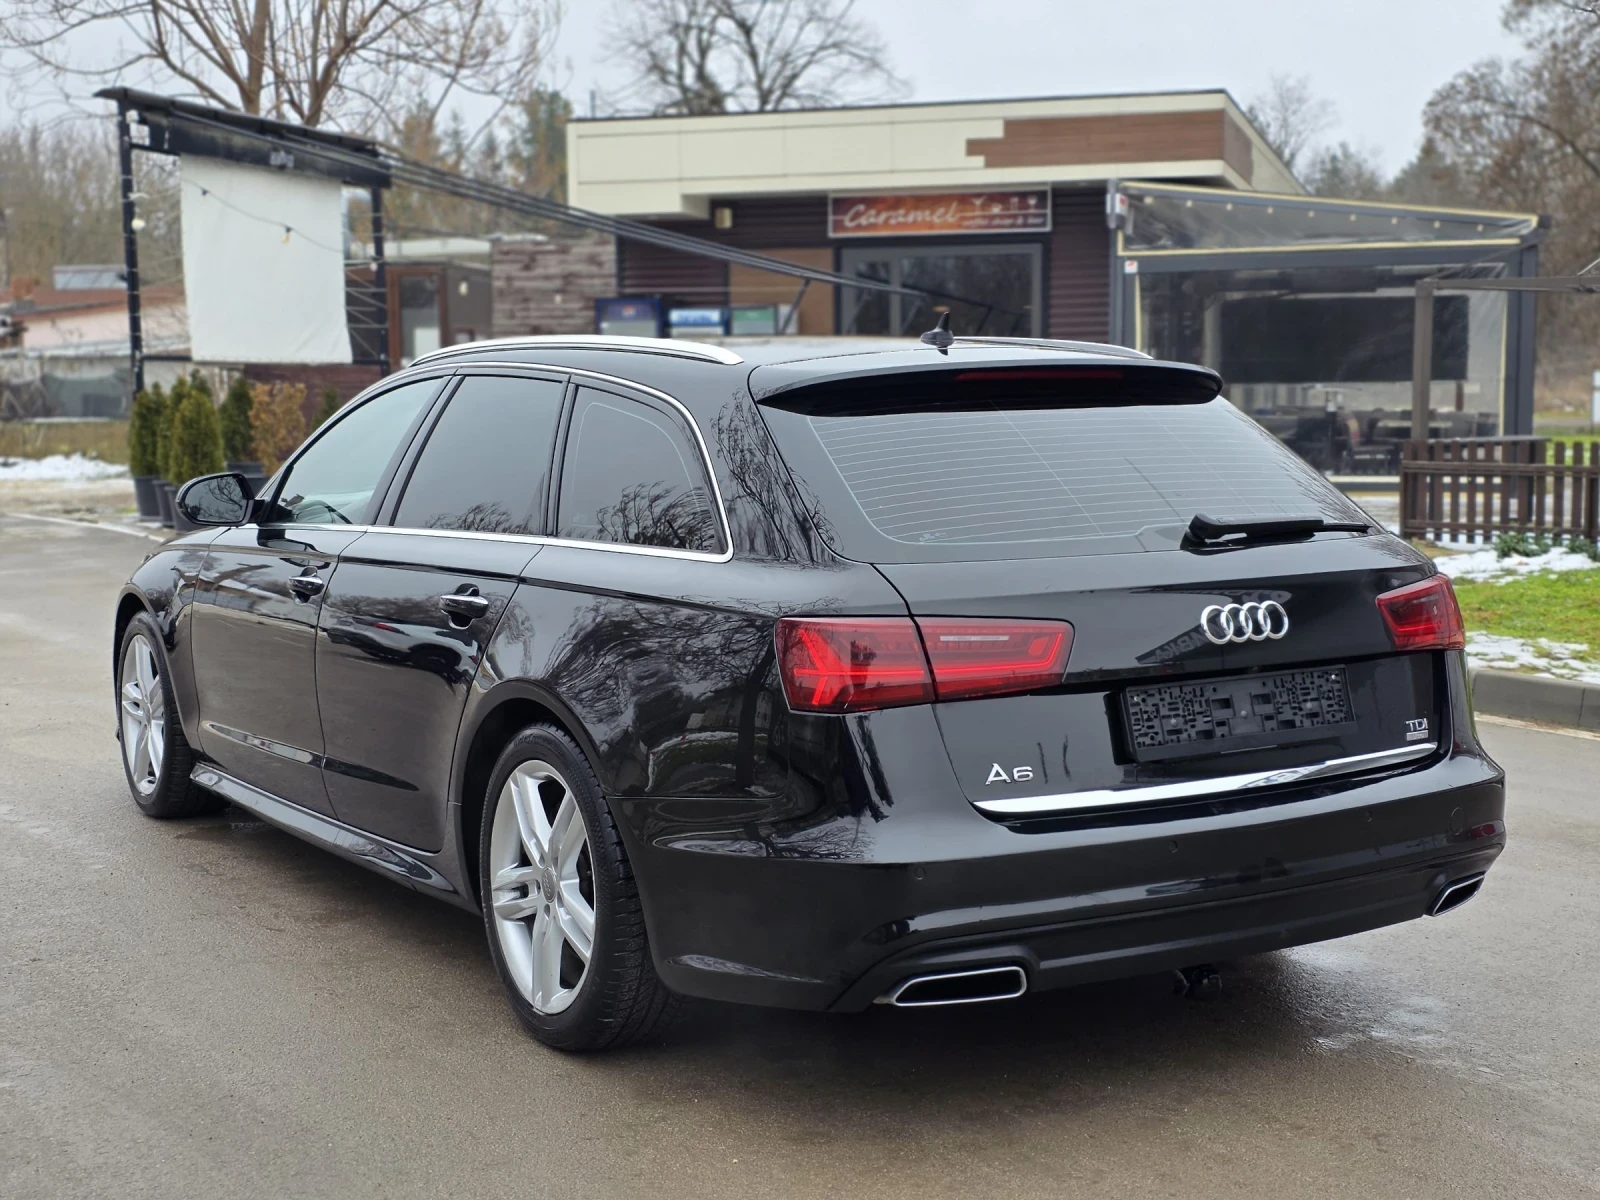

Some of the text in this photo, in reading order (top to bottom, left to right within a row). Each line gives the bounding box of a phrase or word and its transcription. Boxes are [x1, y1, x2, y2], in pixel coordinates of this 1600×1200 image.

[842, 201, 959, 228] Caramel
[1405, 718, 1429, 731] TDI
[985, 763, 1034, 785] A6
